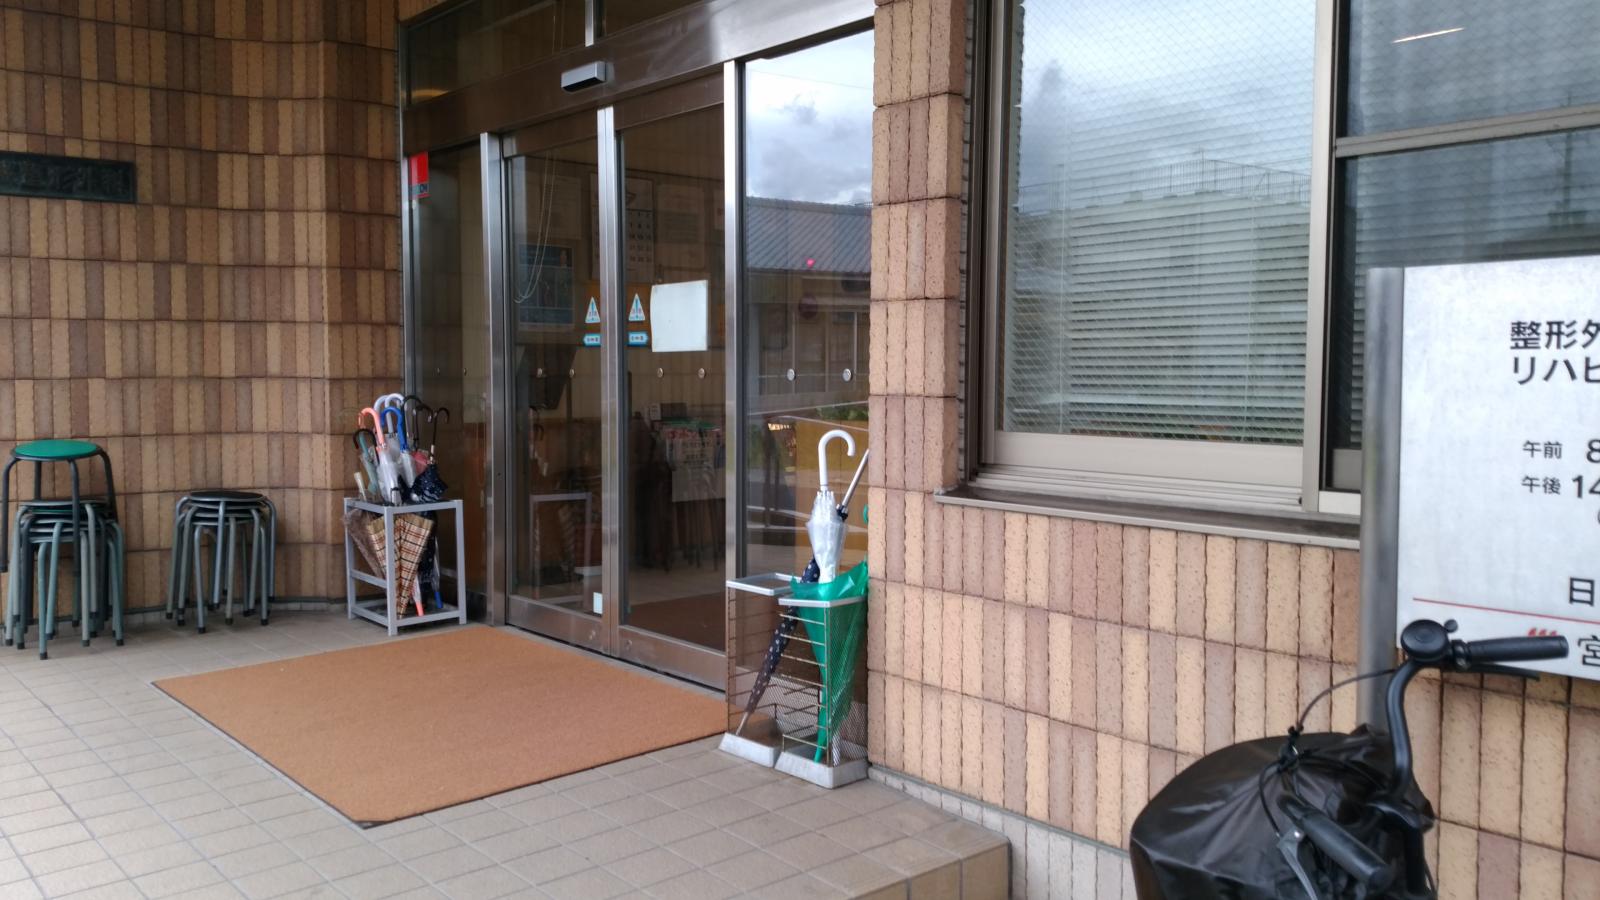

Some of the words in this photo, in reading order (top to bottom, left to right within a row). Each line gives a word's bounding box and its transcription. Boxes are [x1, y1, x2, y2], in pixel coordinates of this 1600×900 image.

[1523, 440, 1562, 459] 午前
[1521, 476, 1561, 495] 午後
[1569, 577, 1595, 607] 日
